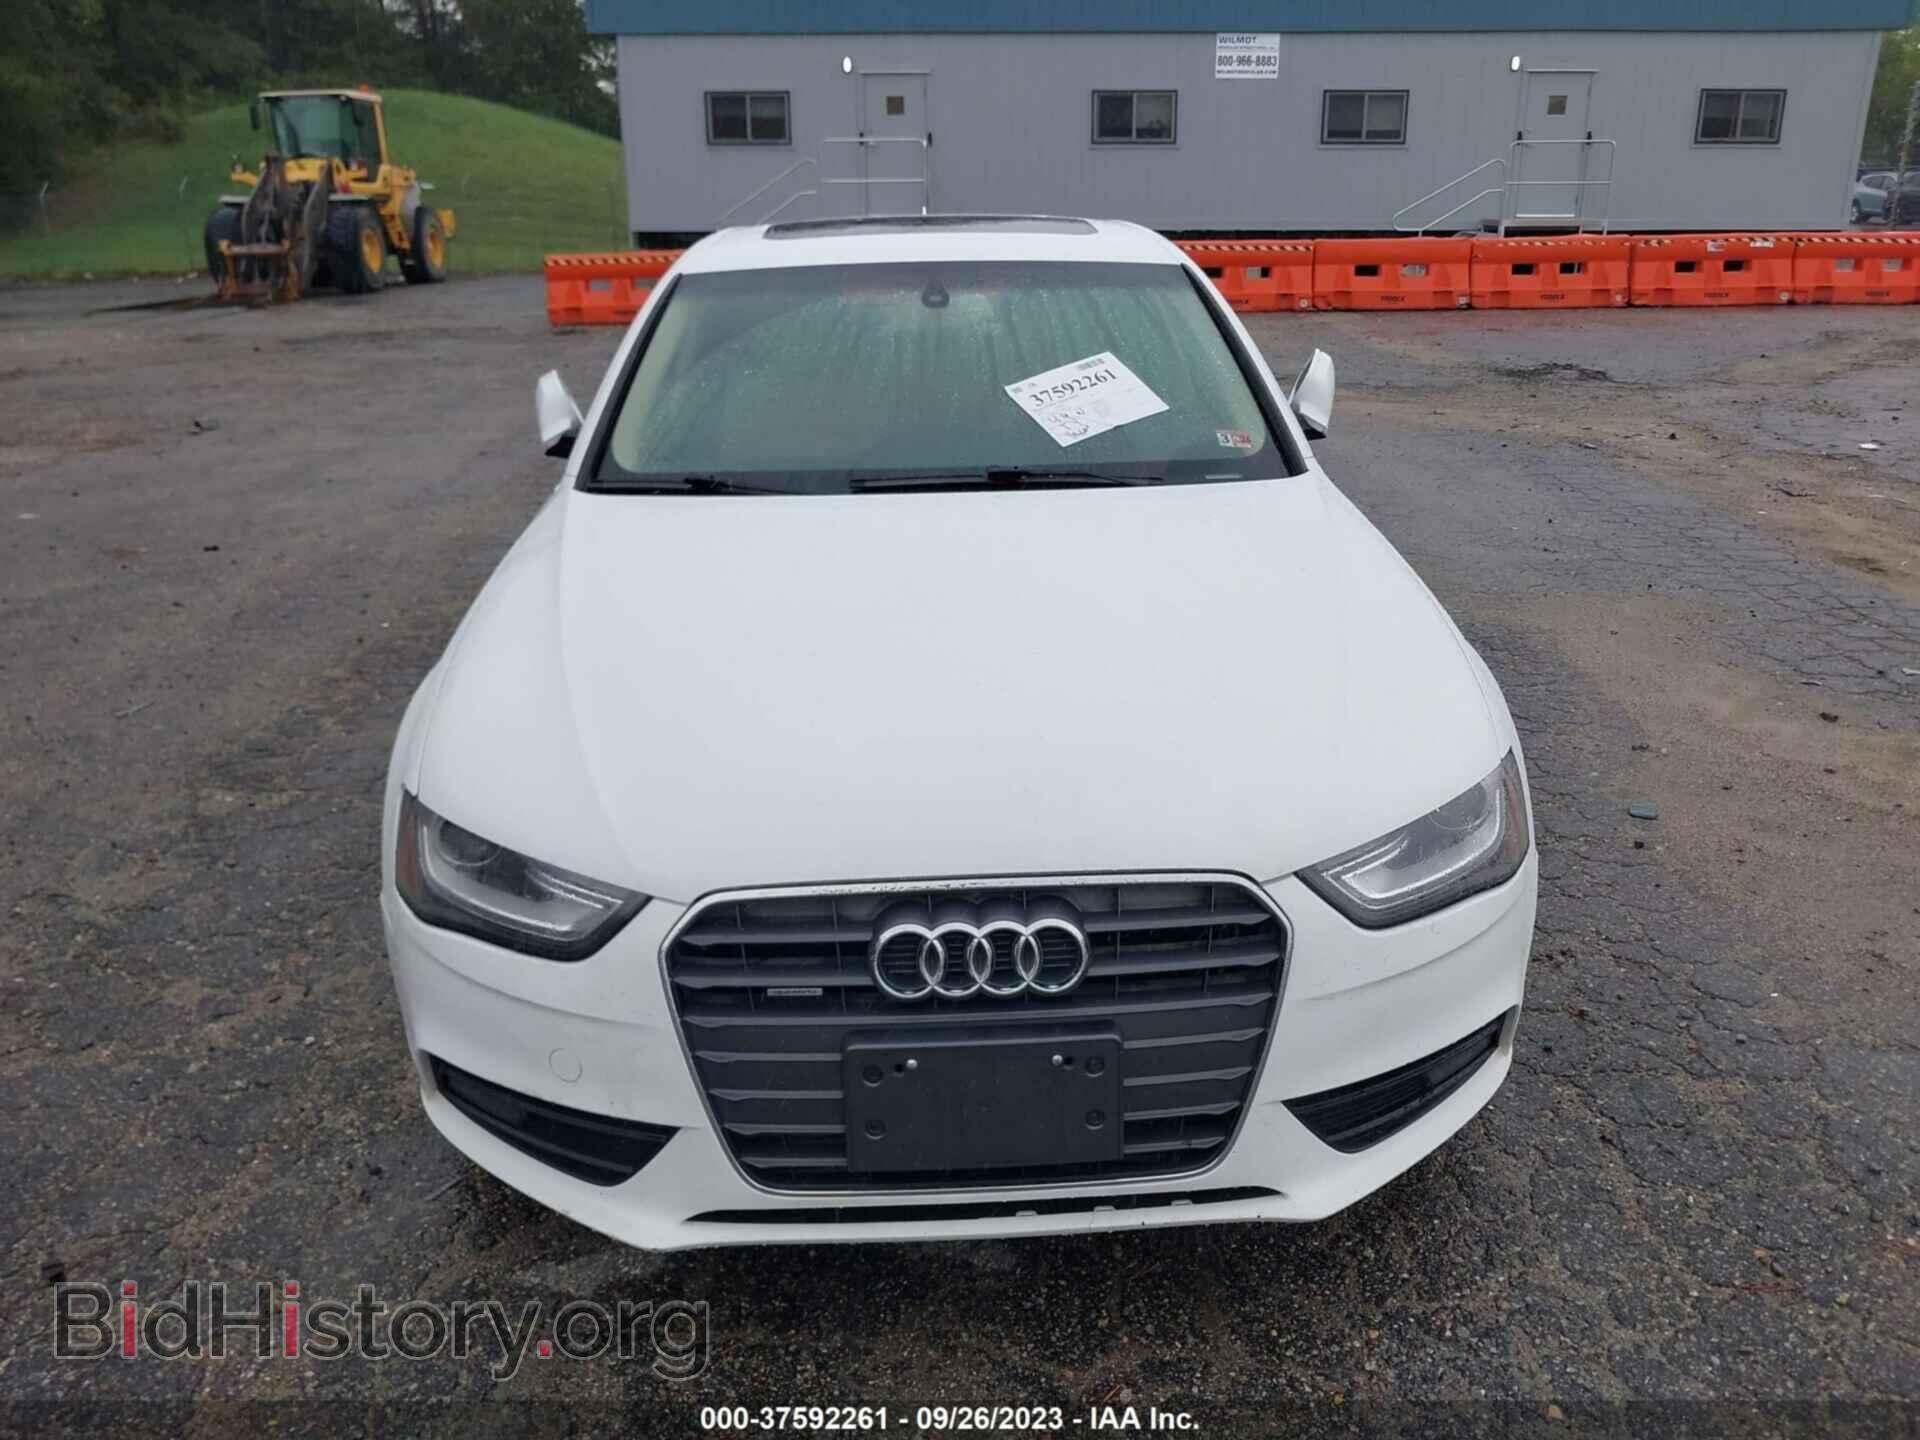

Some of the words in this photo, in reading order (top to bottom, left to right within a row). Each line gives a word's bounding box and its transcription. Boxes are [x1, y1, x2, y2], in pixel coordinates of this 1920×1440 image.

[1218, 36, 1257, 44] WILMOT
[1217, 55, 1278, 67] 800-966-8883
[1029, 368, 1118, 407] 37592261
